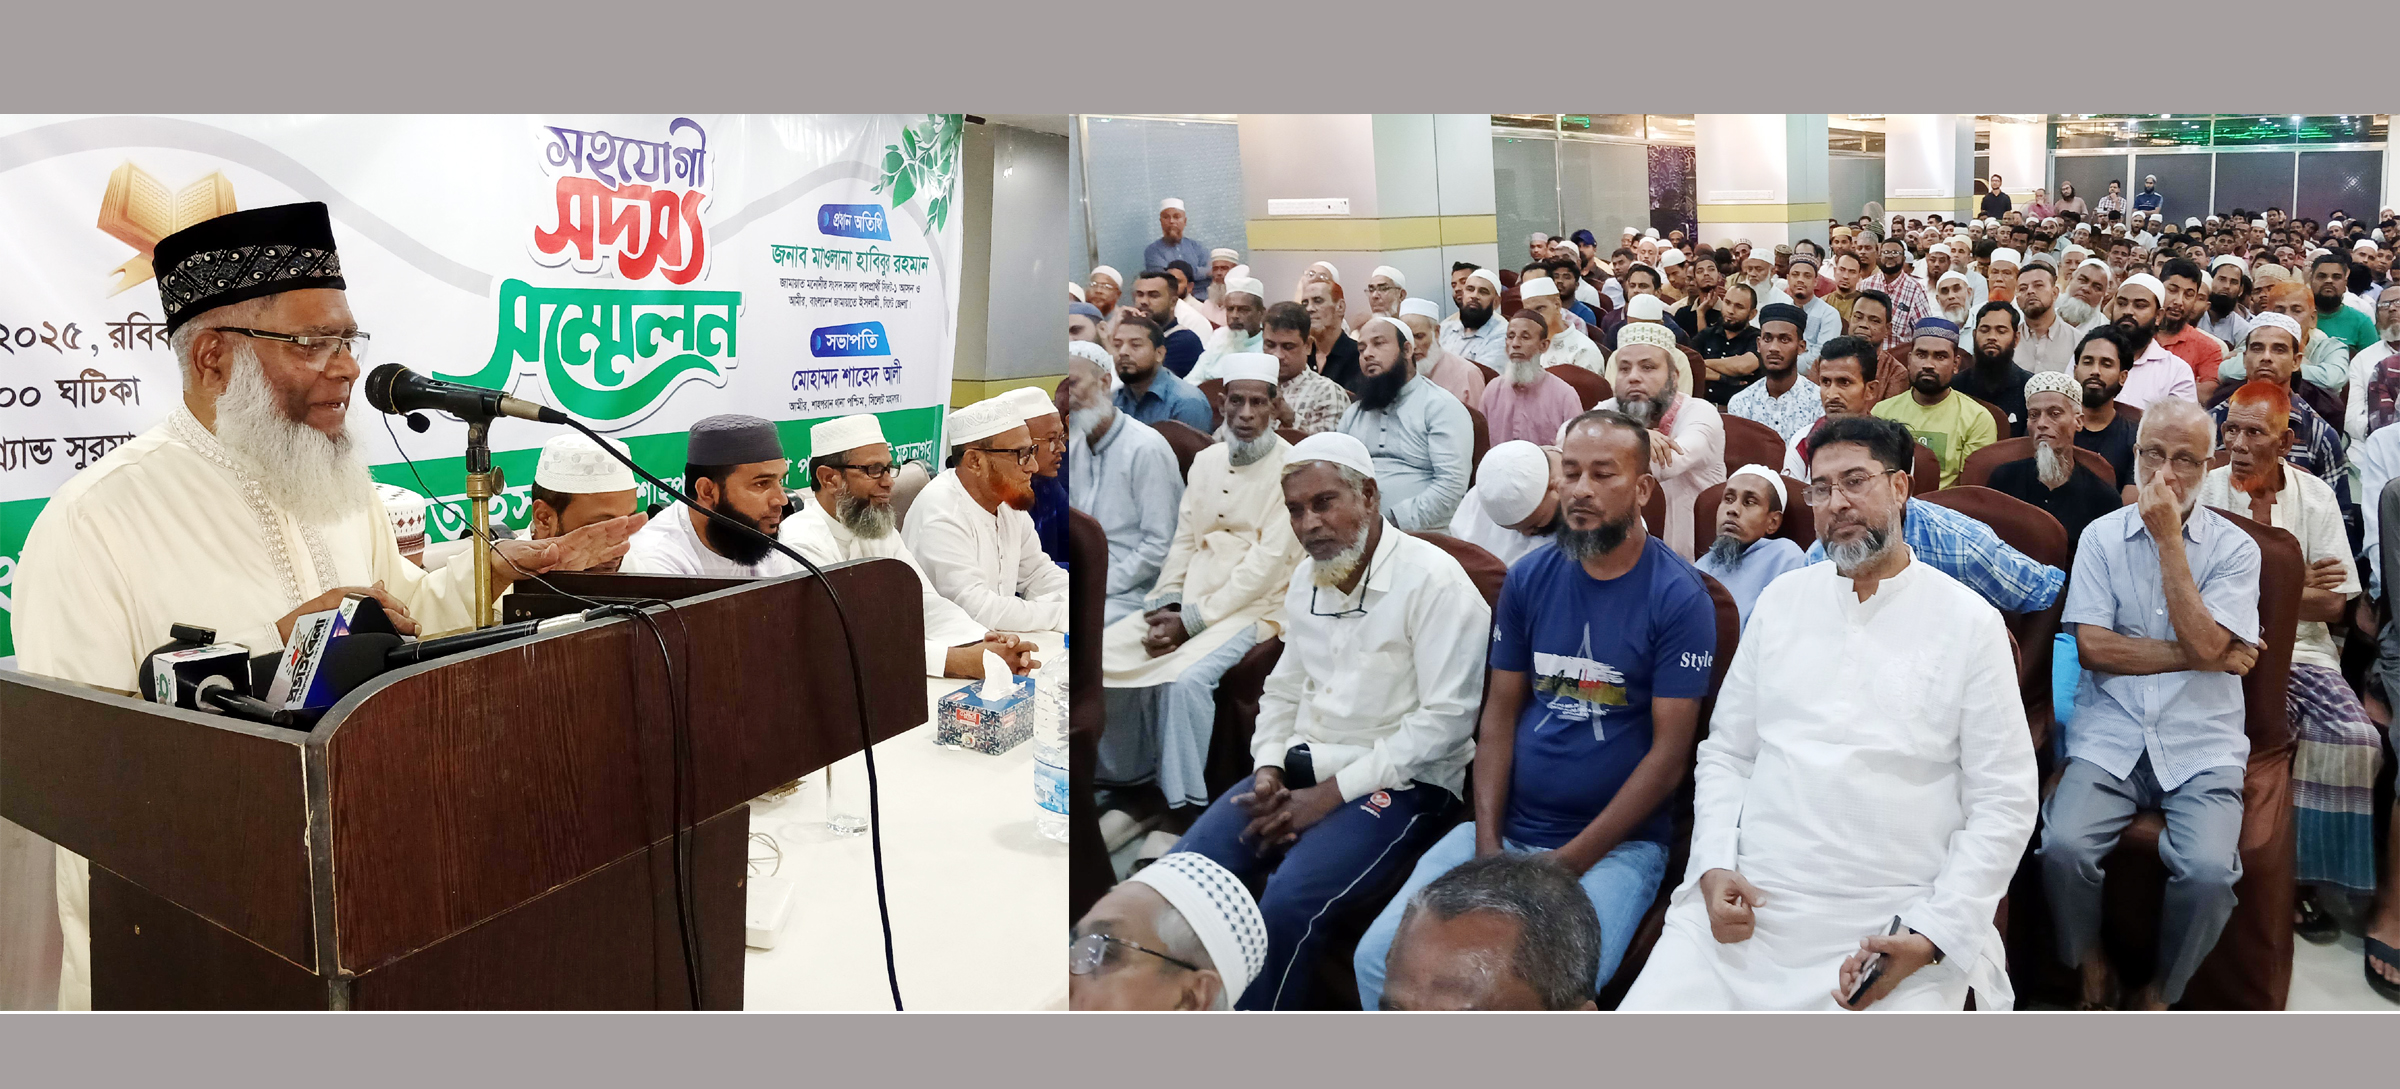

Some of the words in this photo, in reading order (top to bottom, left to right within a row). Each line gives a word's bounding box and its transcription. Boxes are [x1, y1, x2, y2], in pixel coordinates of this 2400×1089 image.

[544, 117, 706, 188] সহযোগী
[535, 176, 706, 284] সদস্য
[832, 211, 851, 231] প্রধান
[854, 210, 883, 233] অতিথি
[771, 244, 808, 269] জনাব
[811, 246, 853, 272] মাওলানা
[856, 245, 890, 279] হাবিবুর
[893, 254, 929, 276] রহমান
[432, 278, 741, 420] সম্মেলন
[825, 328, 879, 351] সভাপতি
[54, 367, 141, 409] ঘটিকা
[791, 367, 839, 391] মোহাম্মদ
[842, 366, 880, 388] শাহেদ
[882, 358, 902, 385] আলী
[1680, 650, 1713, 672] Style
